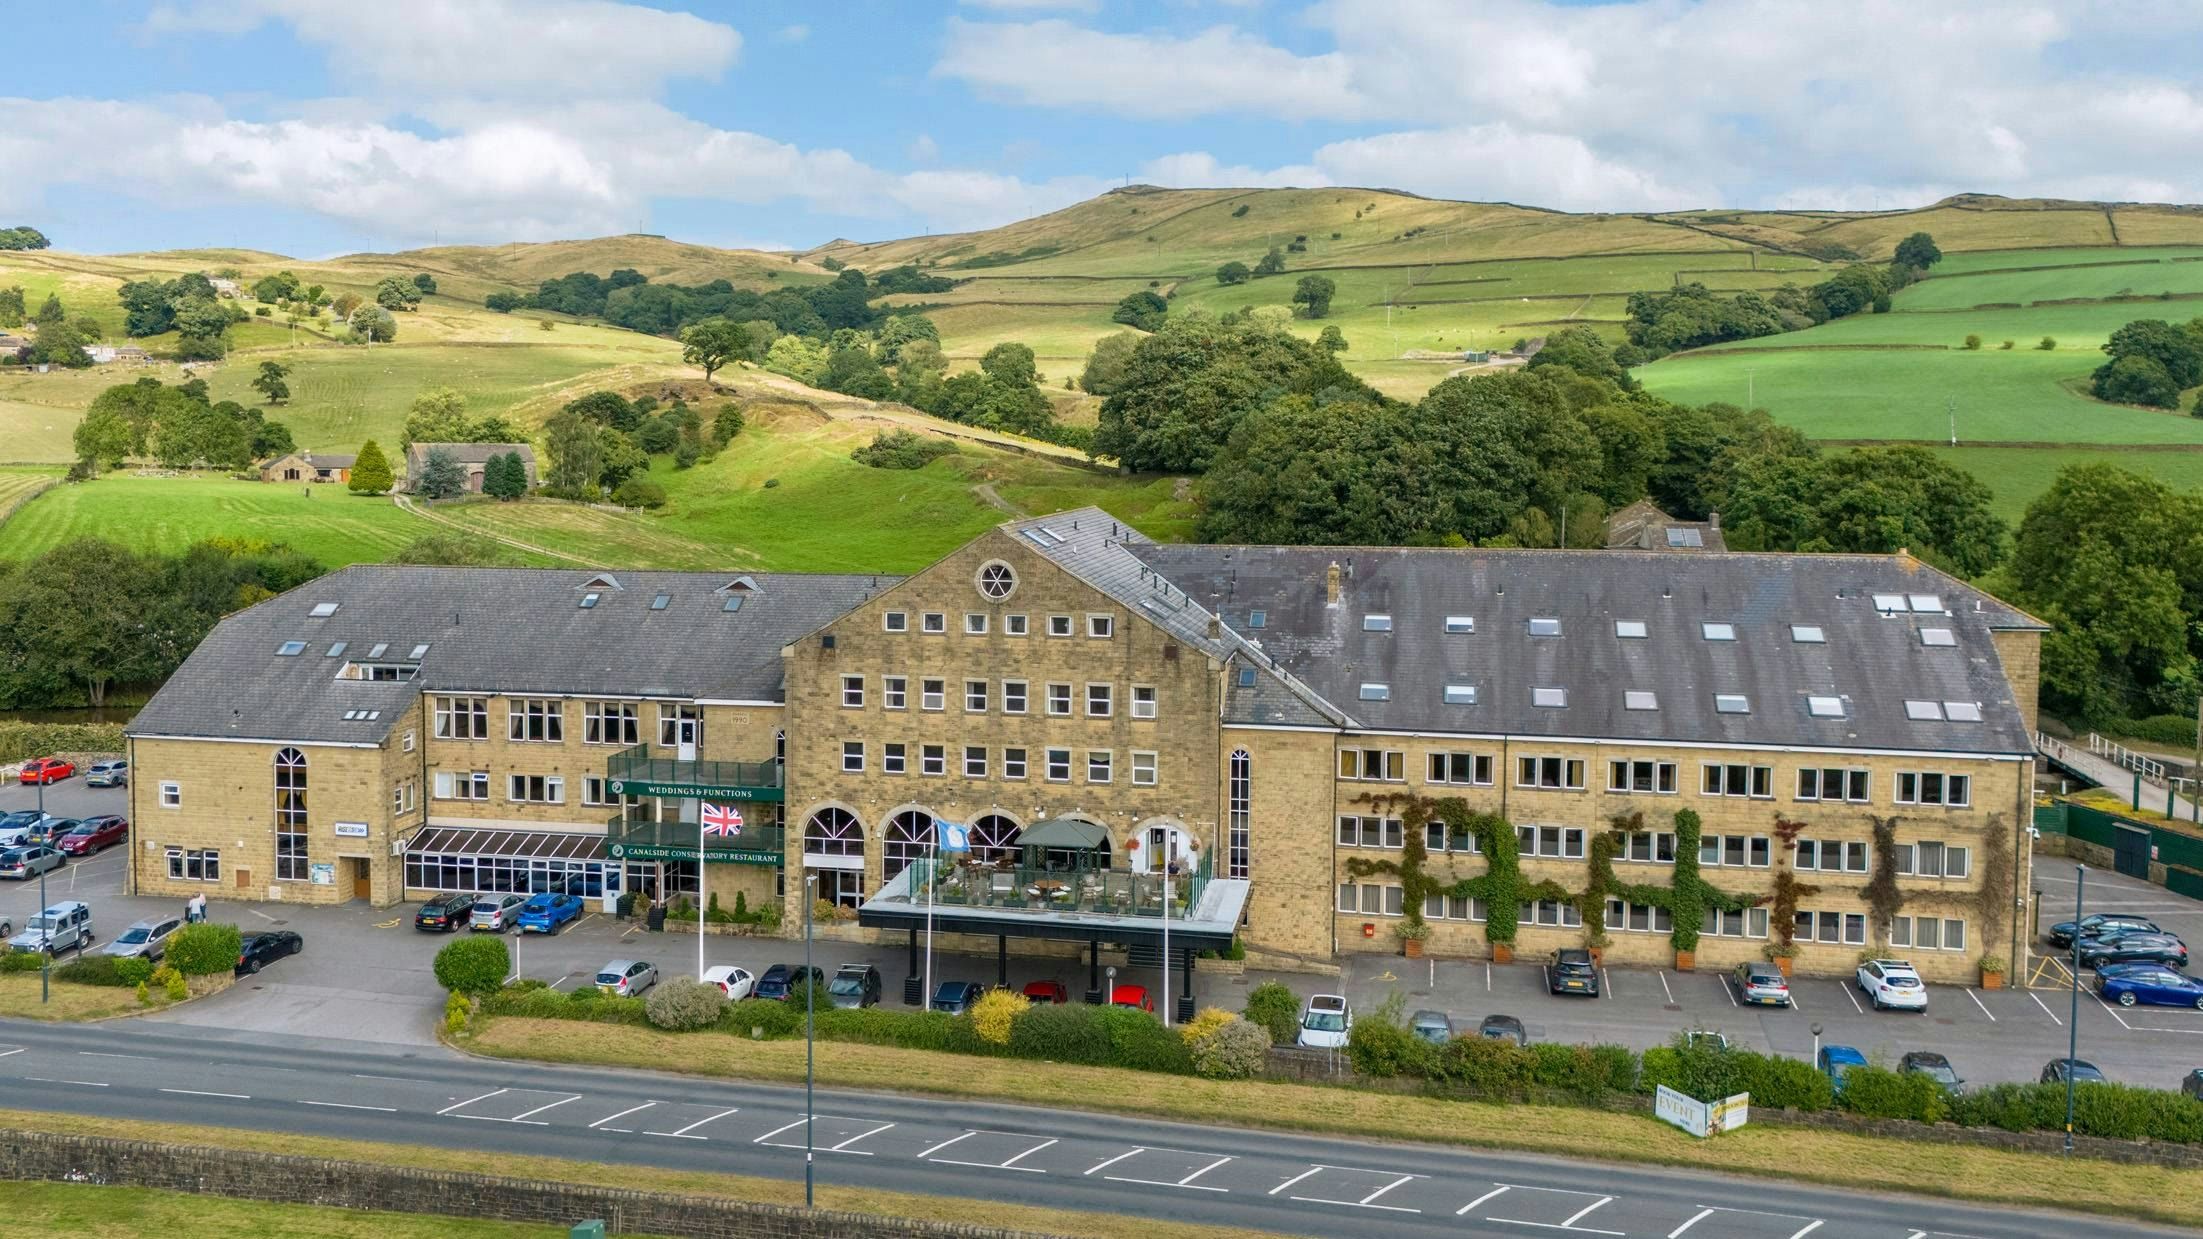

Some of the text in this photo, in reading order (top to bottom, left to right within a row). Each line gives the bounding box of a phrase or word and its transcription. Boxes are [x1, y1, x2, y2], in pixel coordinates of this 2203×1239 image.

[648, 787, 694, 795] WEDDINGS
[703, 788, 752, 798] FUNCTIONS
[628, 848, 669, 857] CANALSIDE
[729, 853, 778, 863] RESTAURANT
[1658, 1096, 1695, 1120] EVENT
